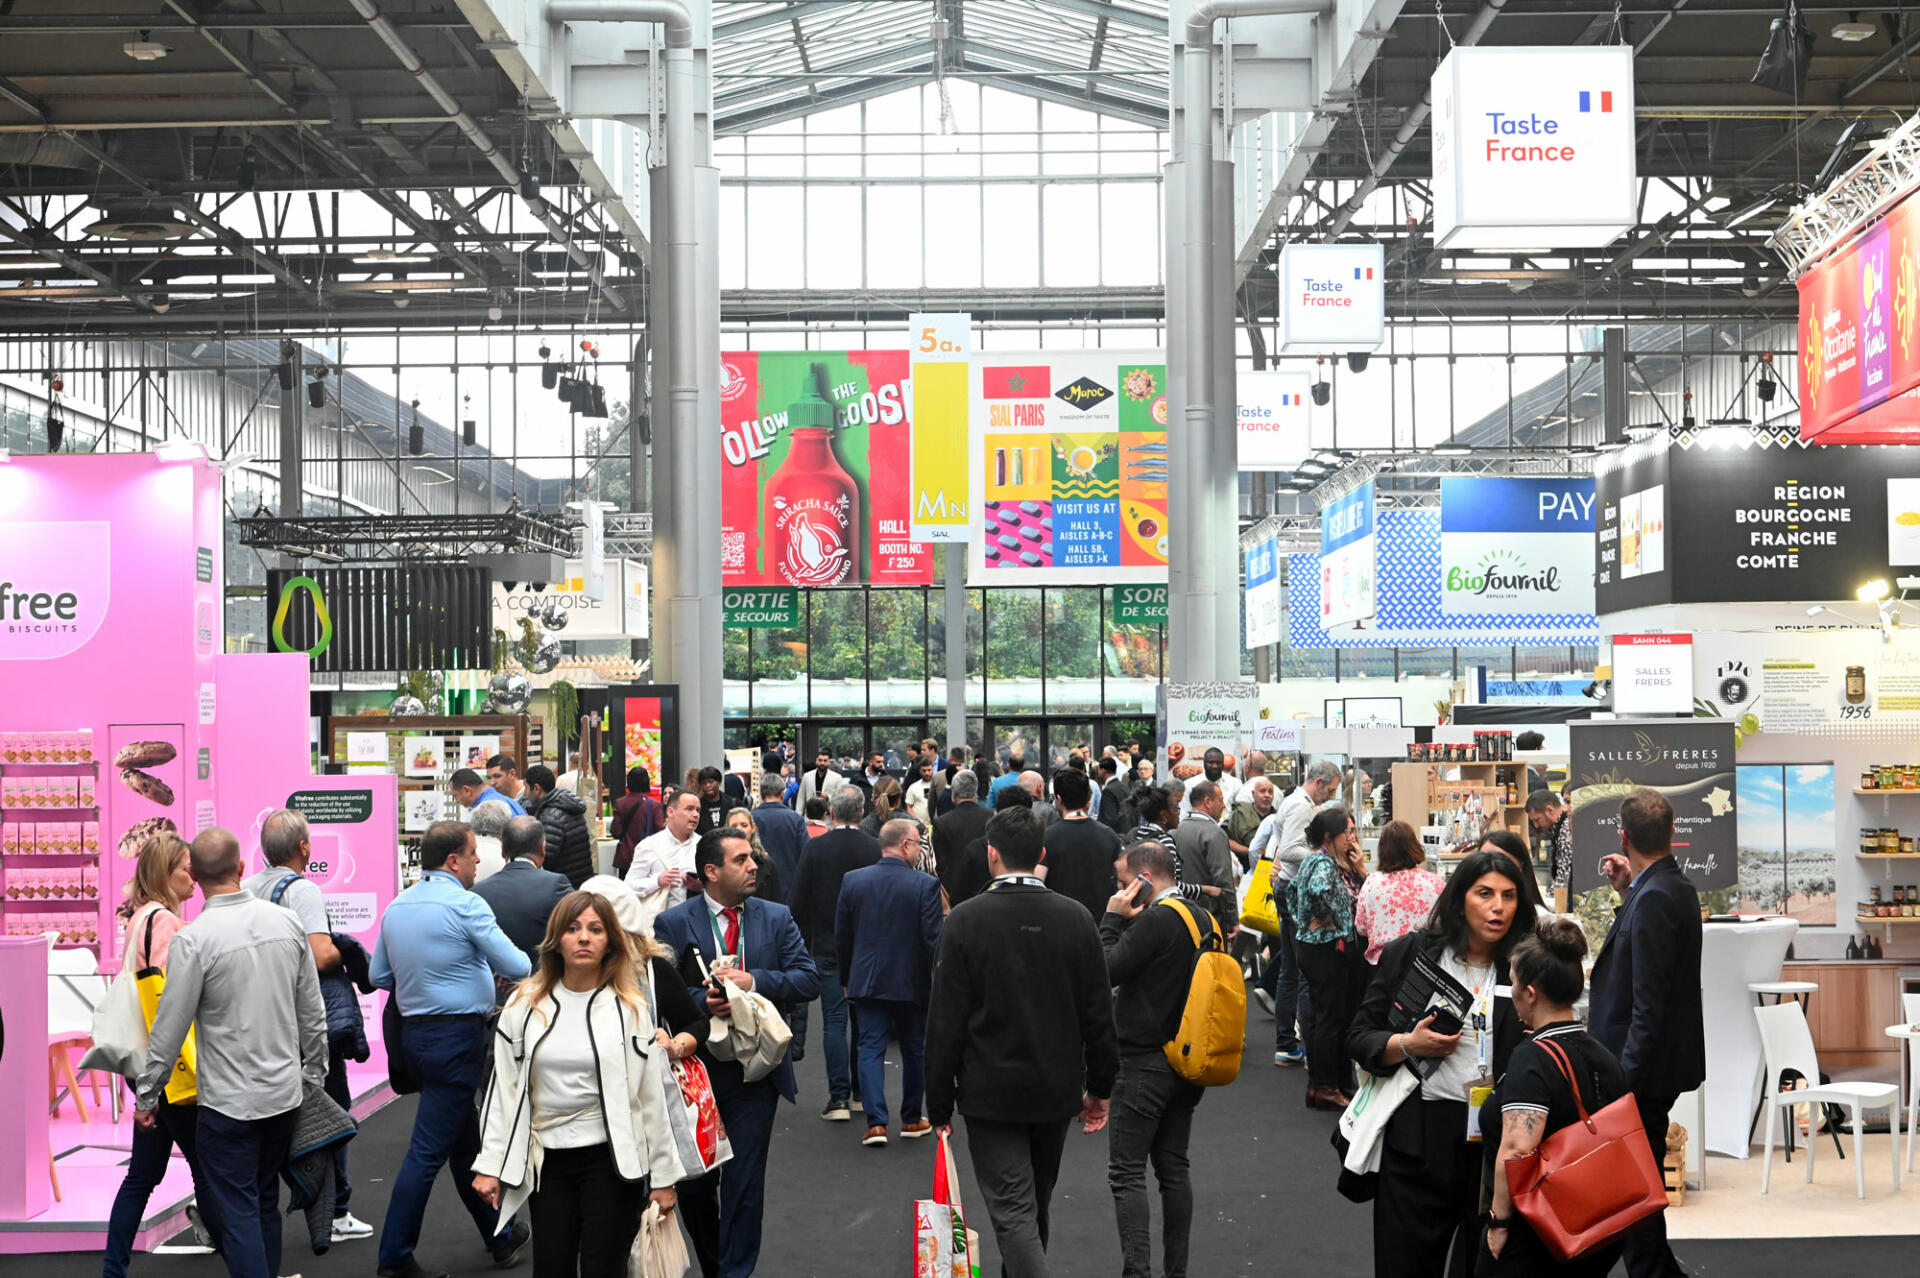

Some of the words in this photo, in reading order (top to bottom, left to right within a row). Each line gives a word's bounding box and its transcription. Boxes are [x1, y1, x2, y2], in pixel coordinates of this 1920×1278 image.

[1486, 112, 1558, 135] Taste
[1486, 139, 1575, 162] France
[1303, 278, 1343, 292] Taste
[1303, 293, 1352, 307] France
[832, 381, 858, 401] THE
[990, 404, 1012, 427] SIAL
[1014, 403, 1045, 427] PARIS
[1236, 405, 1272, 418] Taste
[720, 411, 789, 466] OLLOW
[1056, 503, 1083, 514] VISIT
[1086, 503, 1100, 514] US
[1103, 503, 1116, 514] AT
[1538, 491, 1596, 521] PAY
[775, 498, 821, 530] SRIRACHA
[822, 500, 849, 530] SAUCE
[1735, 509, 1851, 523] BOURGOGNE
[879, 520, 907, 533] HALL
[1070, 521, 1091, 530] HALL
[1060, 532, 1088, 540] AISLES
[1091, 531, 1113, 540] A-B-C
[1751, 532, 1837, 546] FRANCHE
[879, 543, 908, 555] BOOTH
[909, 543, 925, 554] NO.
[1068, 545, 1089, 554] HALL
[889, 558, 895, 568] F
[896, 557, 915, 568] 250
[1065, 555, 1093, 564] AISLES
[1096, 555, 1108, 564] J-K
[777, 560, 800, 585] FLYING
[830, 559, 852, 585] BRAND
[1447, 564, 1560, 595] Biofournil
[0, 582, 78, 621] free
[507, 595, 601, 610] COMTOISE
[1121, 588, 1167, 604] SOR
[733, 612, 790, 623] SECOURS
[1122, 607, 1139, 617] DE
[9, 625, 77, 633] BISCUITS
[1635, 668, 1671, 676] SALLES
[1717, 660, 1752, 677] 1920
[1189, 709, 1240, 724] Biofournil
[1840, 705, 1871, 719] 1956
[1260, 726, 1296, 742] Festins
[1589, 751, 1643, 761] SALLES
[1675, 762, 1699, 770] depuis
[1684, 853, 1718, 876] famille
